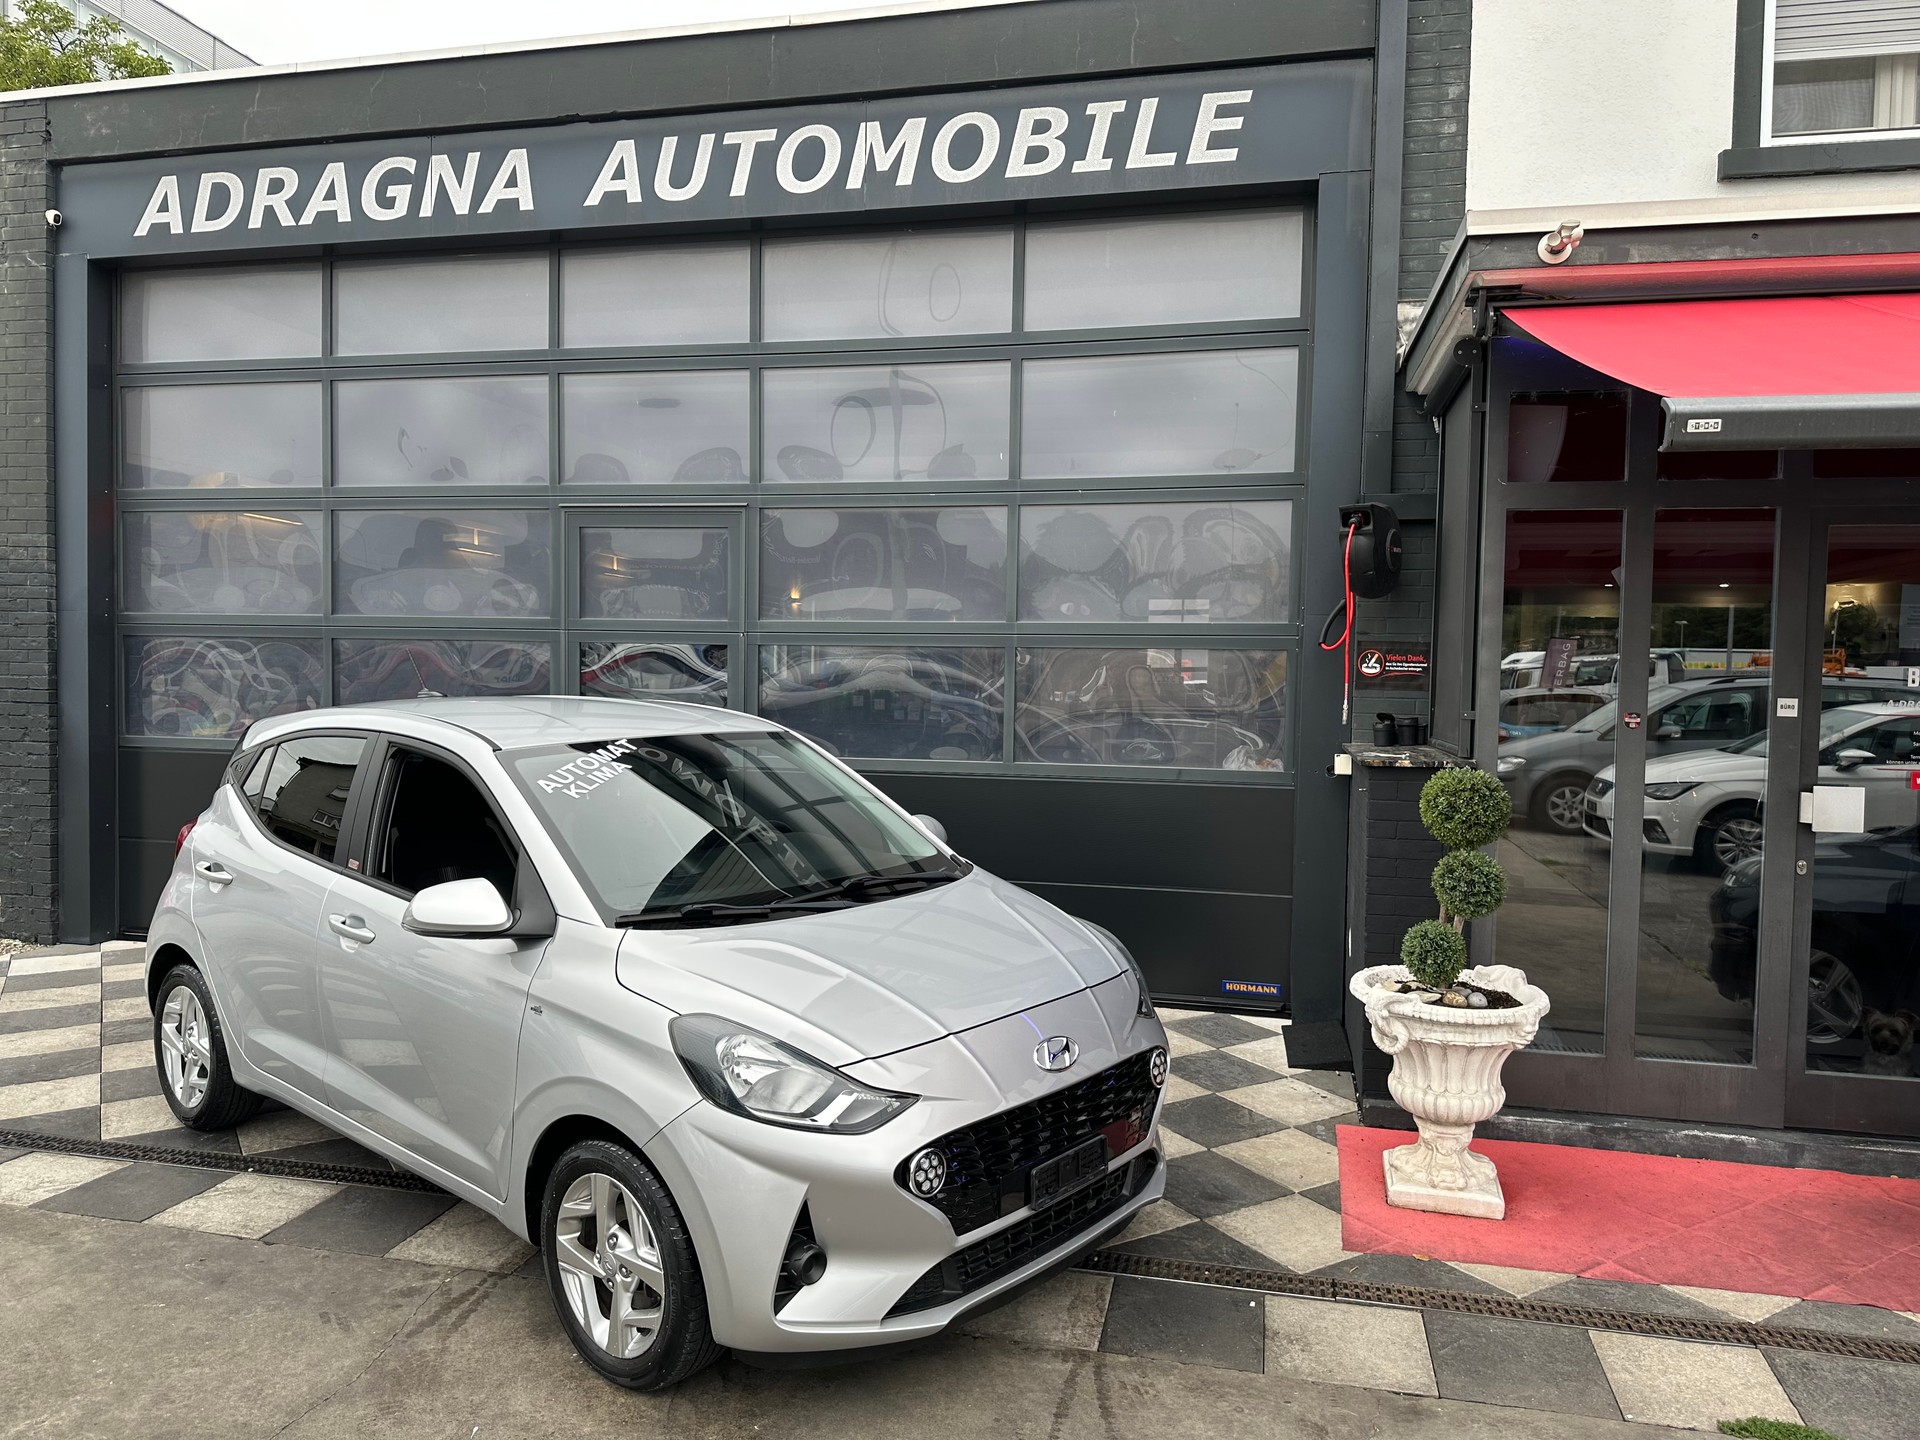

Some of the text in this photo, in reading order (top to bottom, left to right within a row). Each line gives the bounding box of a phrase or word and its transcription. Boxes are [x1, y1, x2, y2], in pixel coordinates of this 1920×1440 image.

[133, 89, 1254, 237] ADRAGNA AUTOMOBILE
[1385, 653, 1406, 662] Vielen
[537, 738, 638, 795] AUTOMAT
[562, 760, 633, 799] KLIMA
